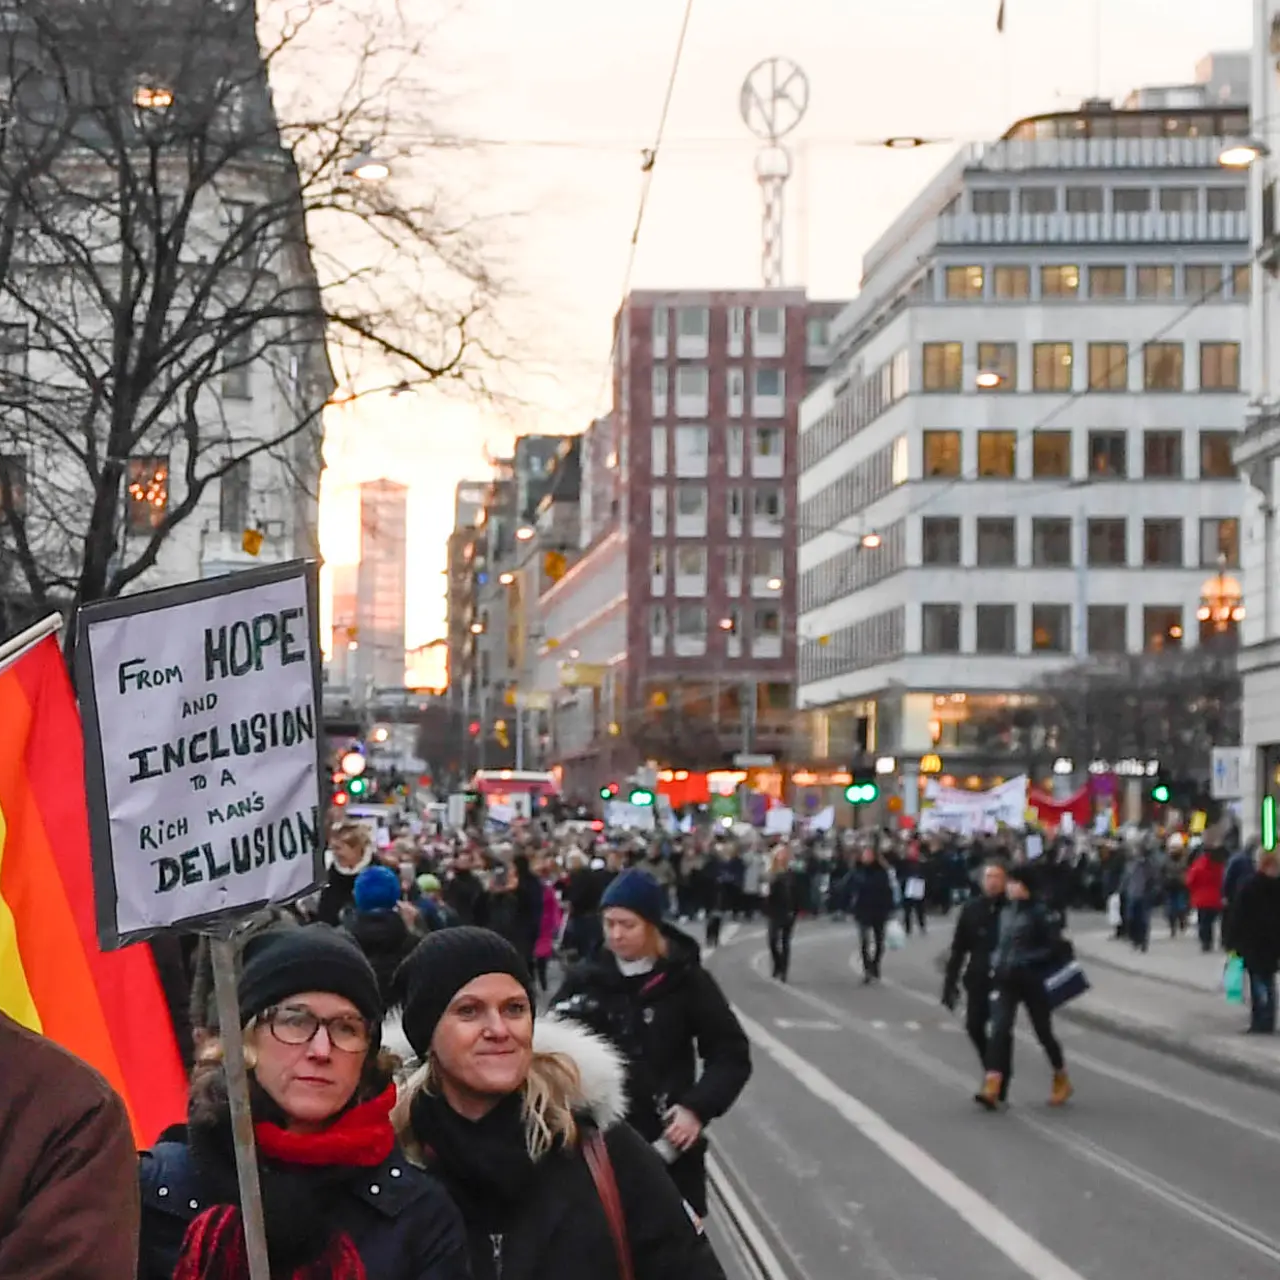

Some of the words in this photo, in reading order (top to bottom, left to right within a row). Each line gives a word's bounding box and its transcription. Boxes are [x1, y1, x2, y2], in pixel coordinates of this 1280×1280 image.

[203, 606, 306, 682] HOPE
[181, 692, 219, 719] AND
[127, 703, 315, 784] INCLUSION
[189, 773, 208, 791] TO
[220, 768, 237, 787] A
[206, 790, 266, 826] MAN'S
[149, 805, 321, 895] DELUSION
